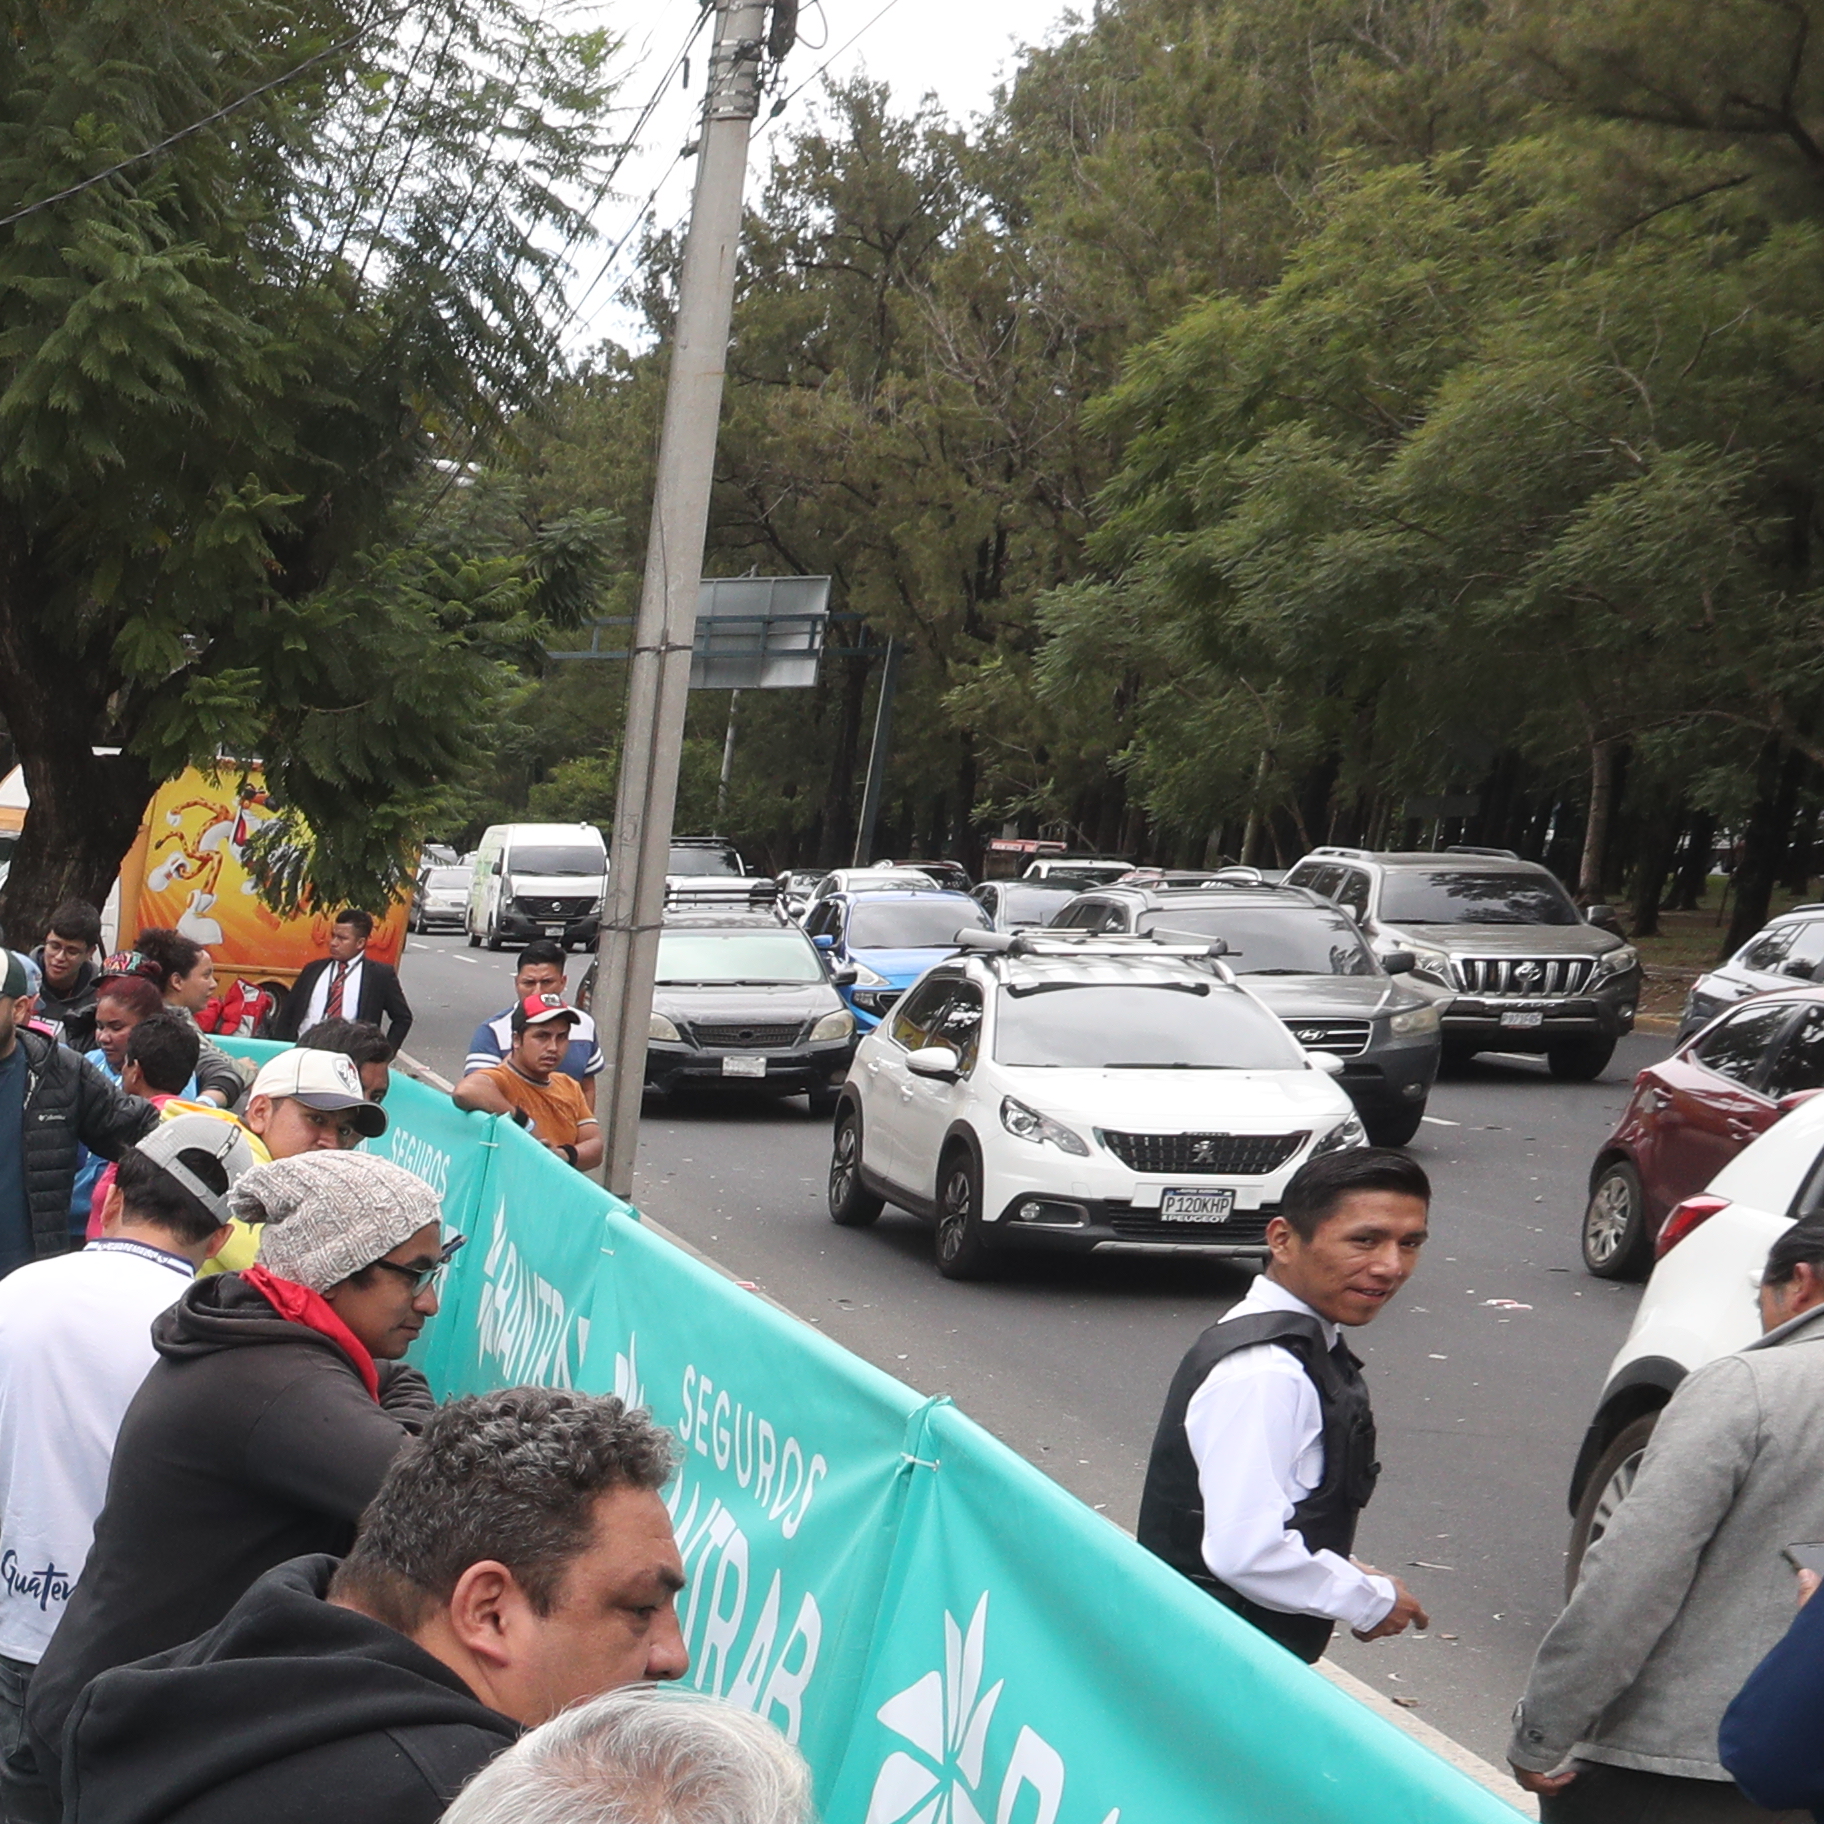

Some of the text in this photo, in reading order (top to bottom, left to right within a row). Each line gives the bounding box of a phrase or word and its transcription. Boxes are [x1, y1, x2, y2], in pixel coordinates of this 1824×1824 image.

[1165, 1196, 1230, 1213] P120KHP
[1168, 1214, 1228, 1223] PEUGEOT
[679, 1364, 827, 1540] SEGUROS
